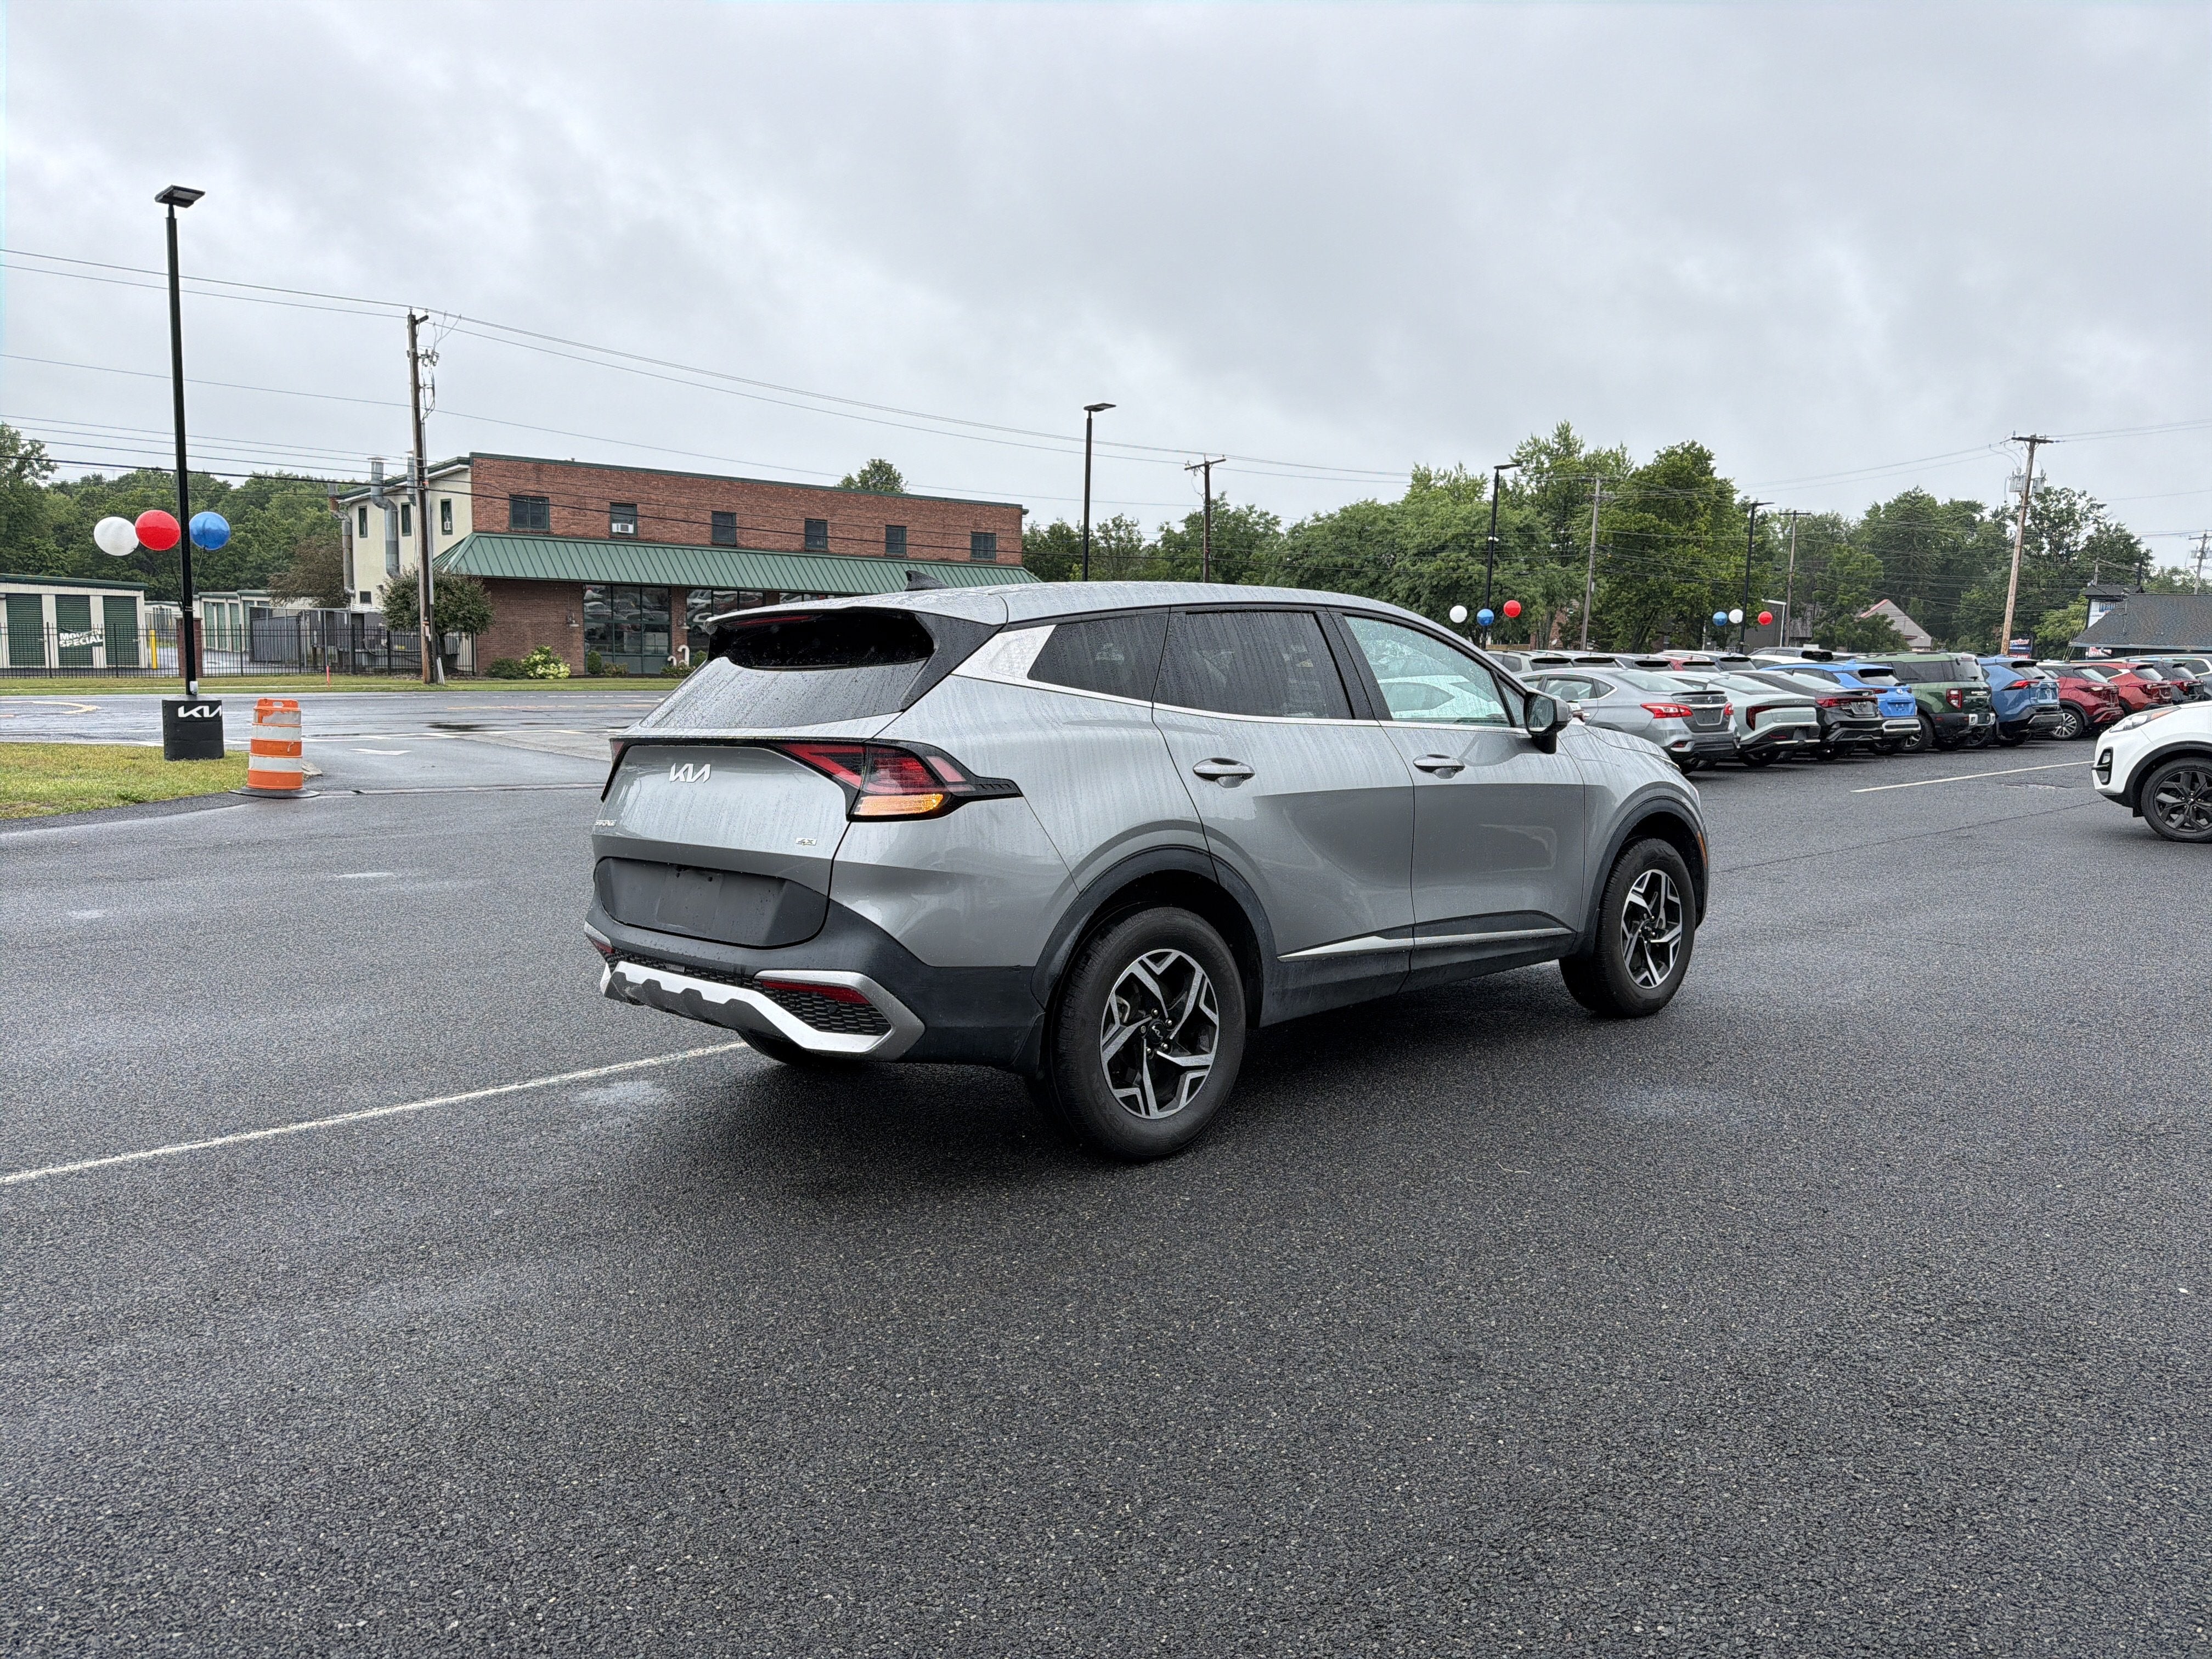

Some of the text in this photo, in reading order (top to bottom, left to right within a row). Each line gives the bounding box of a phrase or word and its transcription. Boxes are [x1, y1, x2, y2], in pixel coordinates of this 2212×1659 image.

[59, 635, 103, 647] SPECIAL
[178, 706, 222, 718] KIA
[669, 763, 711, 783] KIA
